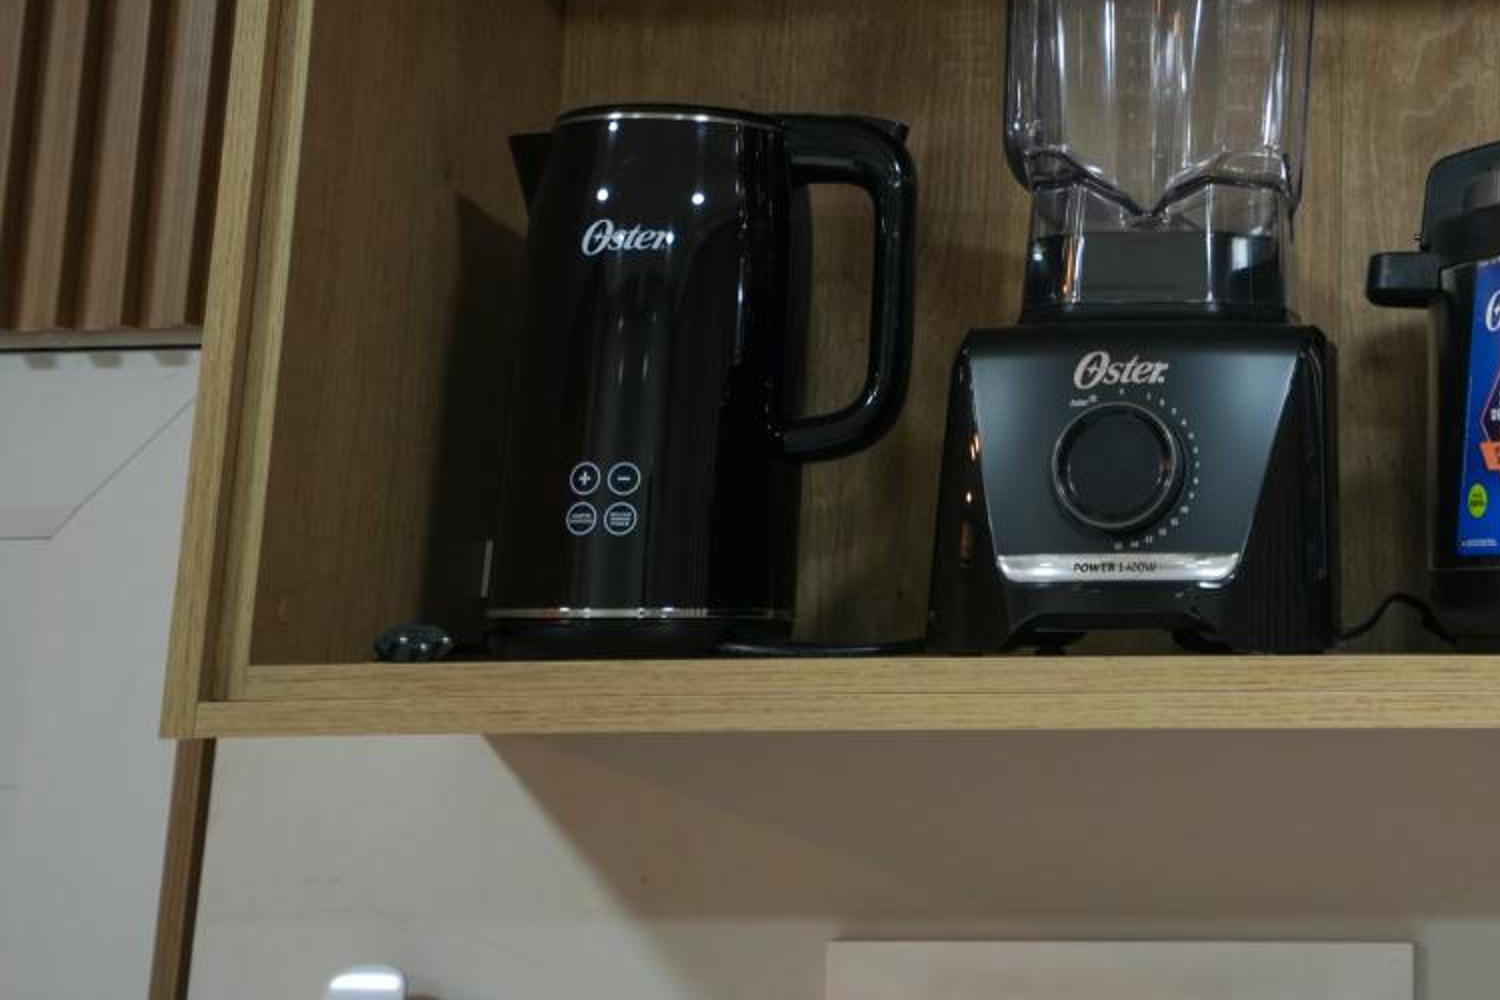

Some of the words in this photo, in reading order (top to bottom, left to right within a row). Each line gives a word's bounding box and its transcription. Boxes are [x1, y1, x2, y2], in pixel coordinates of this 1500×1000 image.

[581, 219, 674, 256] Oster
[1074, 351, 1169, 389] Oster
[1073, 562, 1115, 573] POWER
